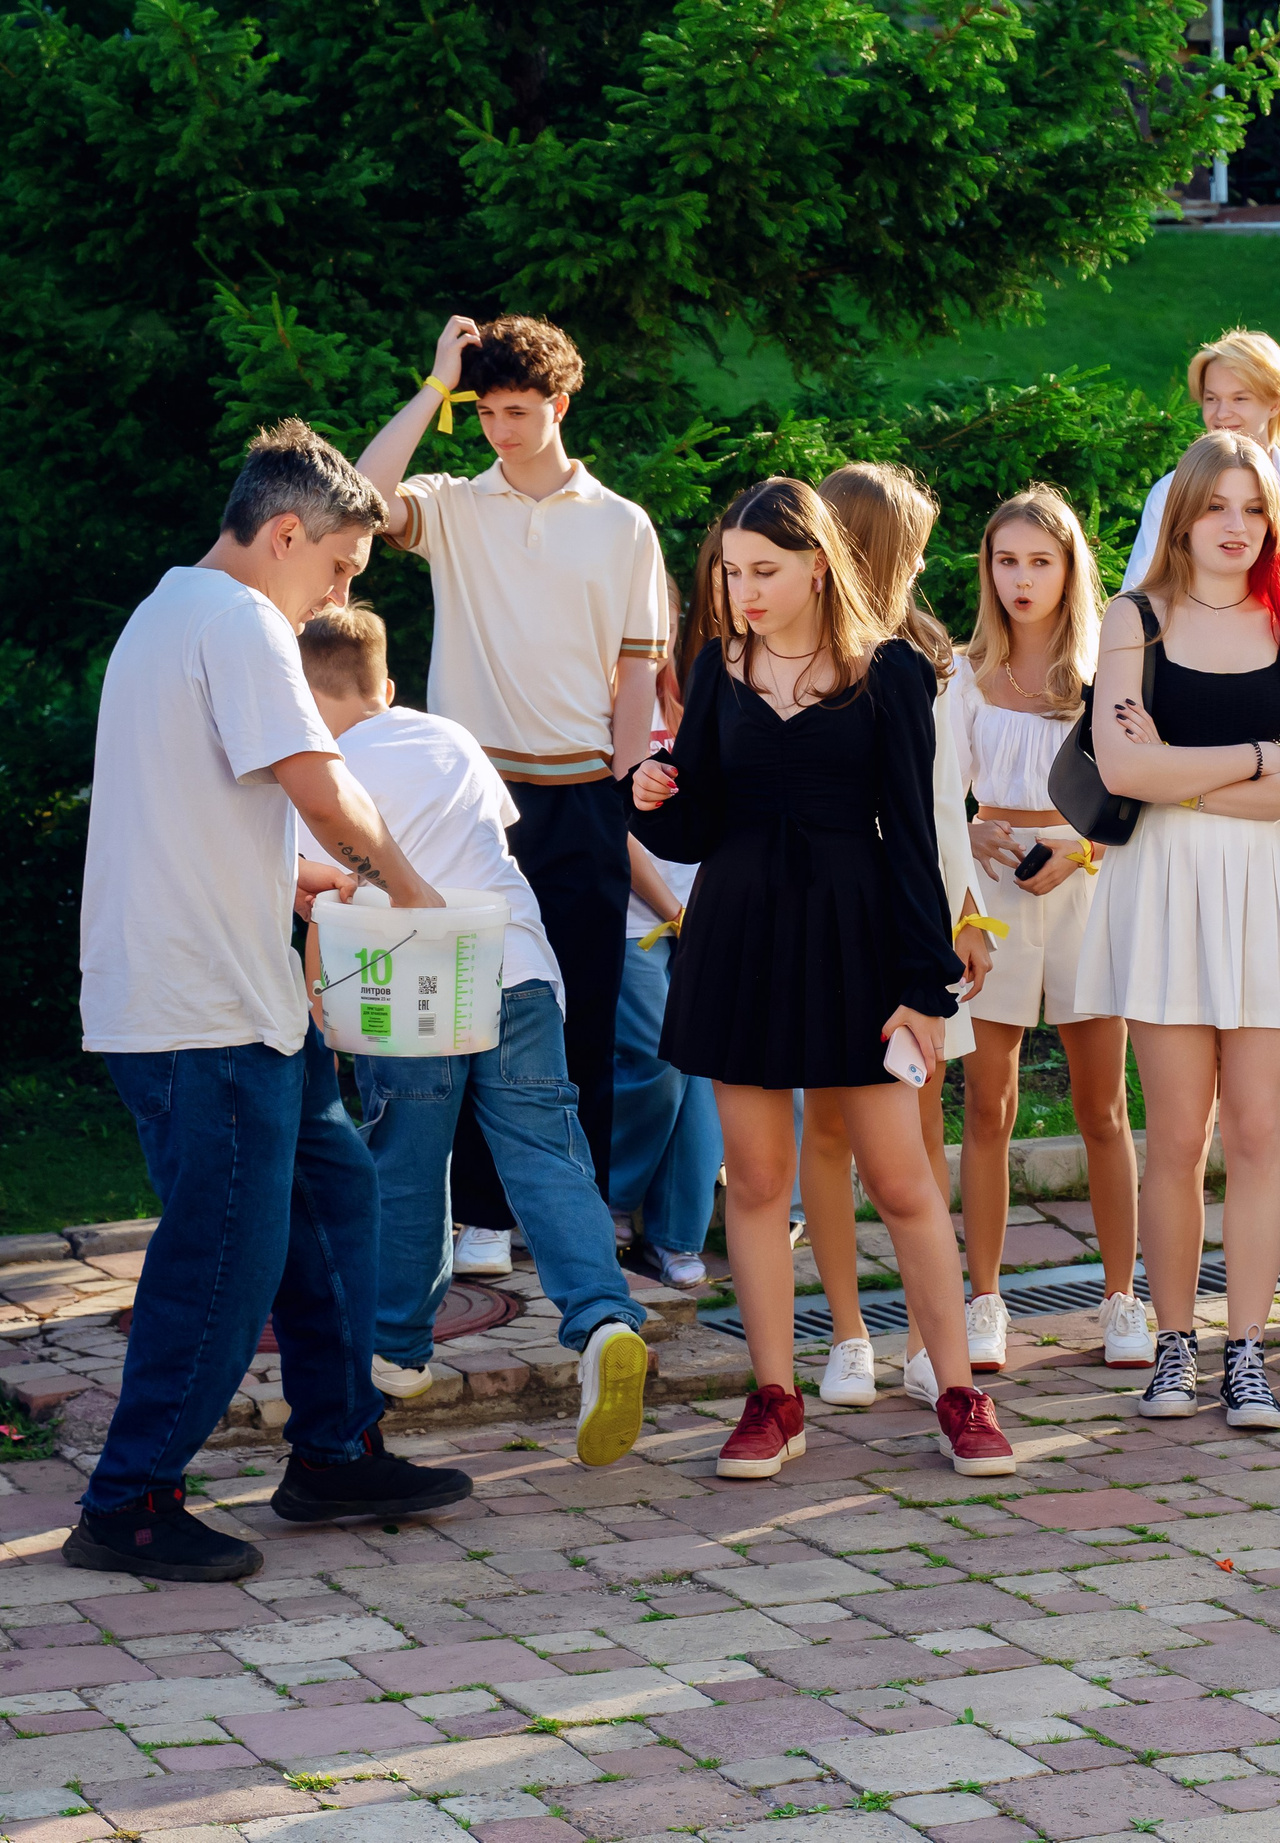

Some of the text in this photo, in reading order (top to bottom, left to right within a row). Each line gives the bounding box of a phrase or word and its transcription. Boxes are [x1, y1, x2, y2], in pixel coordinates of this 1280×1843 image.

[354, 948, 392, 986] 10
[360, 987, 391, 996] литров
[418, 999, 430, 1011] EAC
